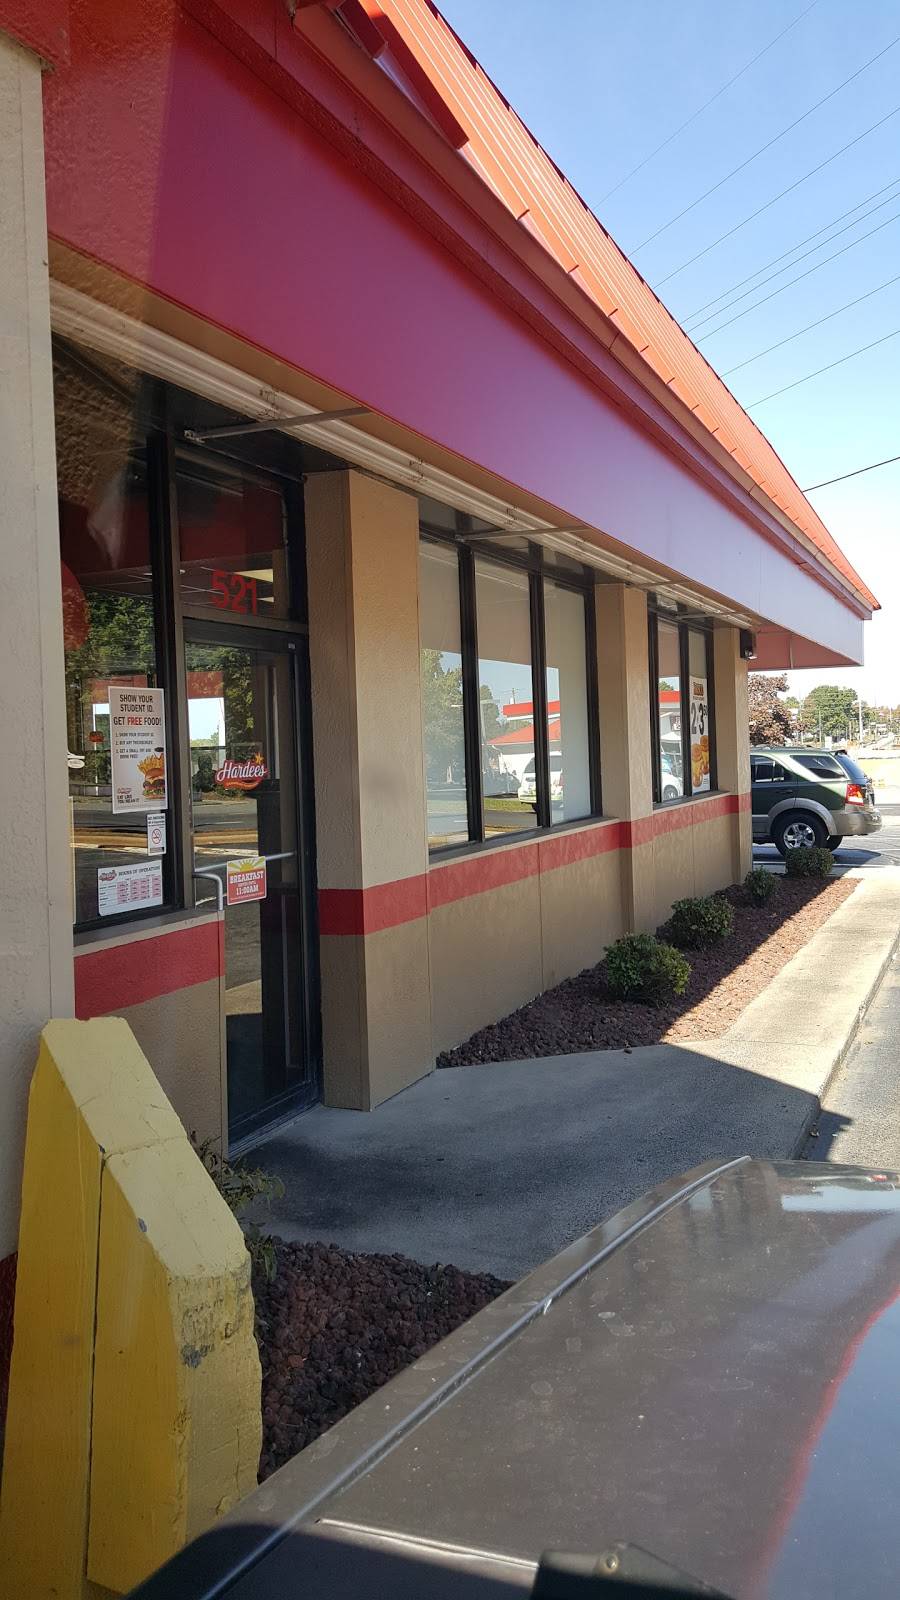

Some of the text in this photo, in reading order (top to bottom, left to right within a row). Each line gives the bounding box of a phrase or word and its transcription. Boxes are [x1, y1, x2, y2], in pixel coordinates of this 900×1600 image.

[211, 570, 257, 616] 521
[119, 694, 155, 704] SHOW YOUR
[120, 704, 146, 713] STUDENT
[113, 716, 162, 726] GET FREE FOOD!
[229, 870, 264, 884] BREAKFAST
